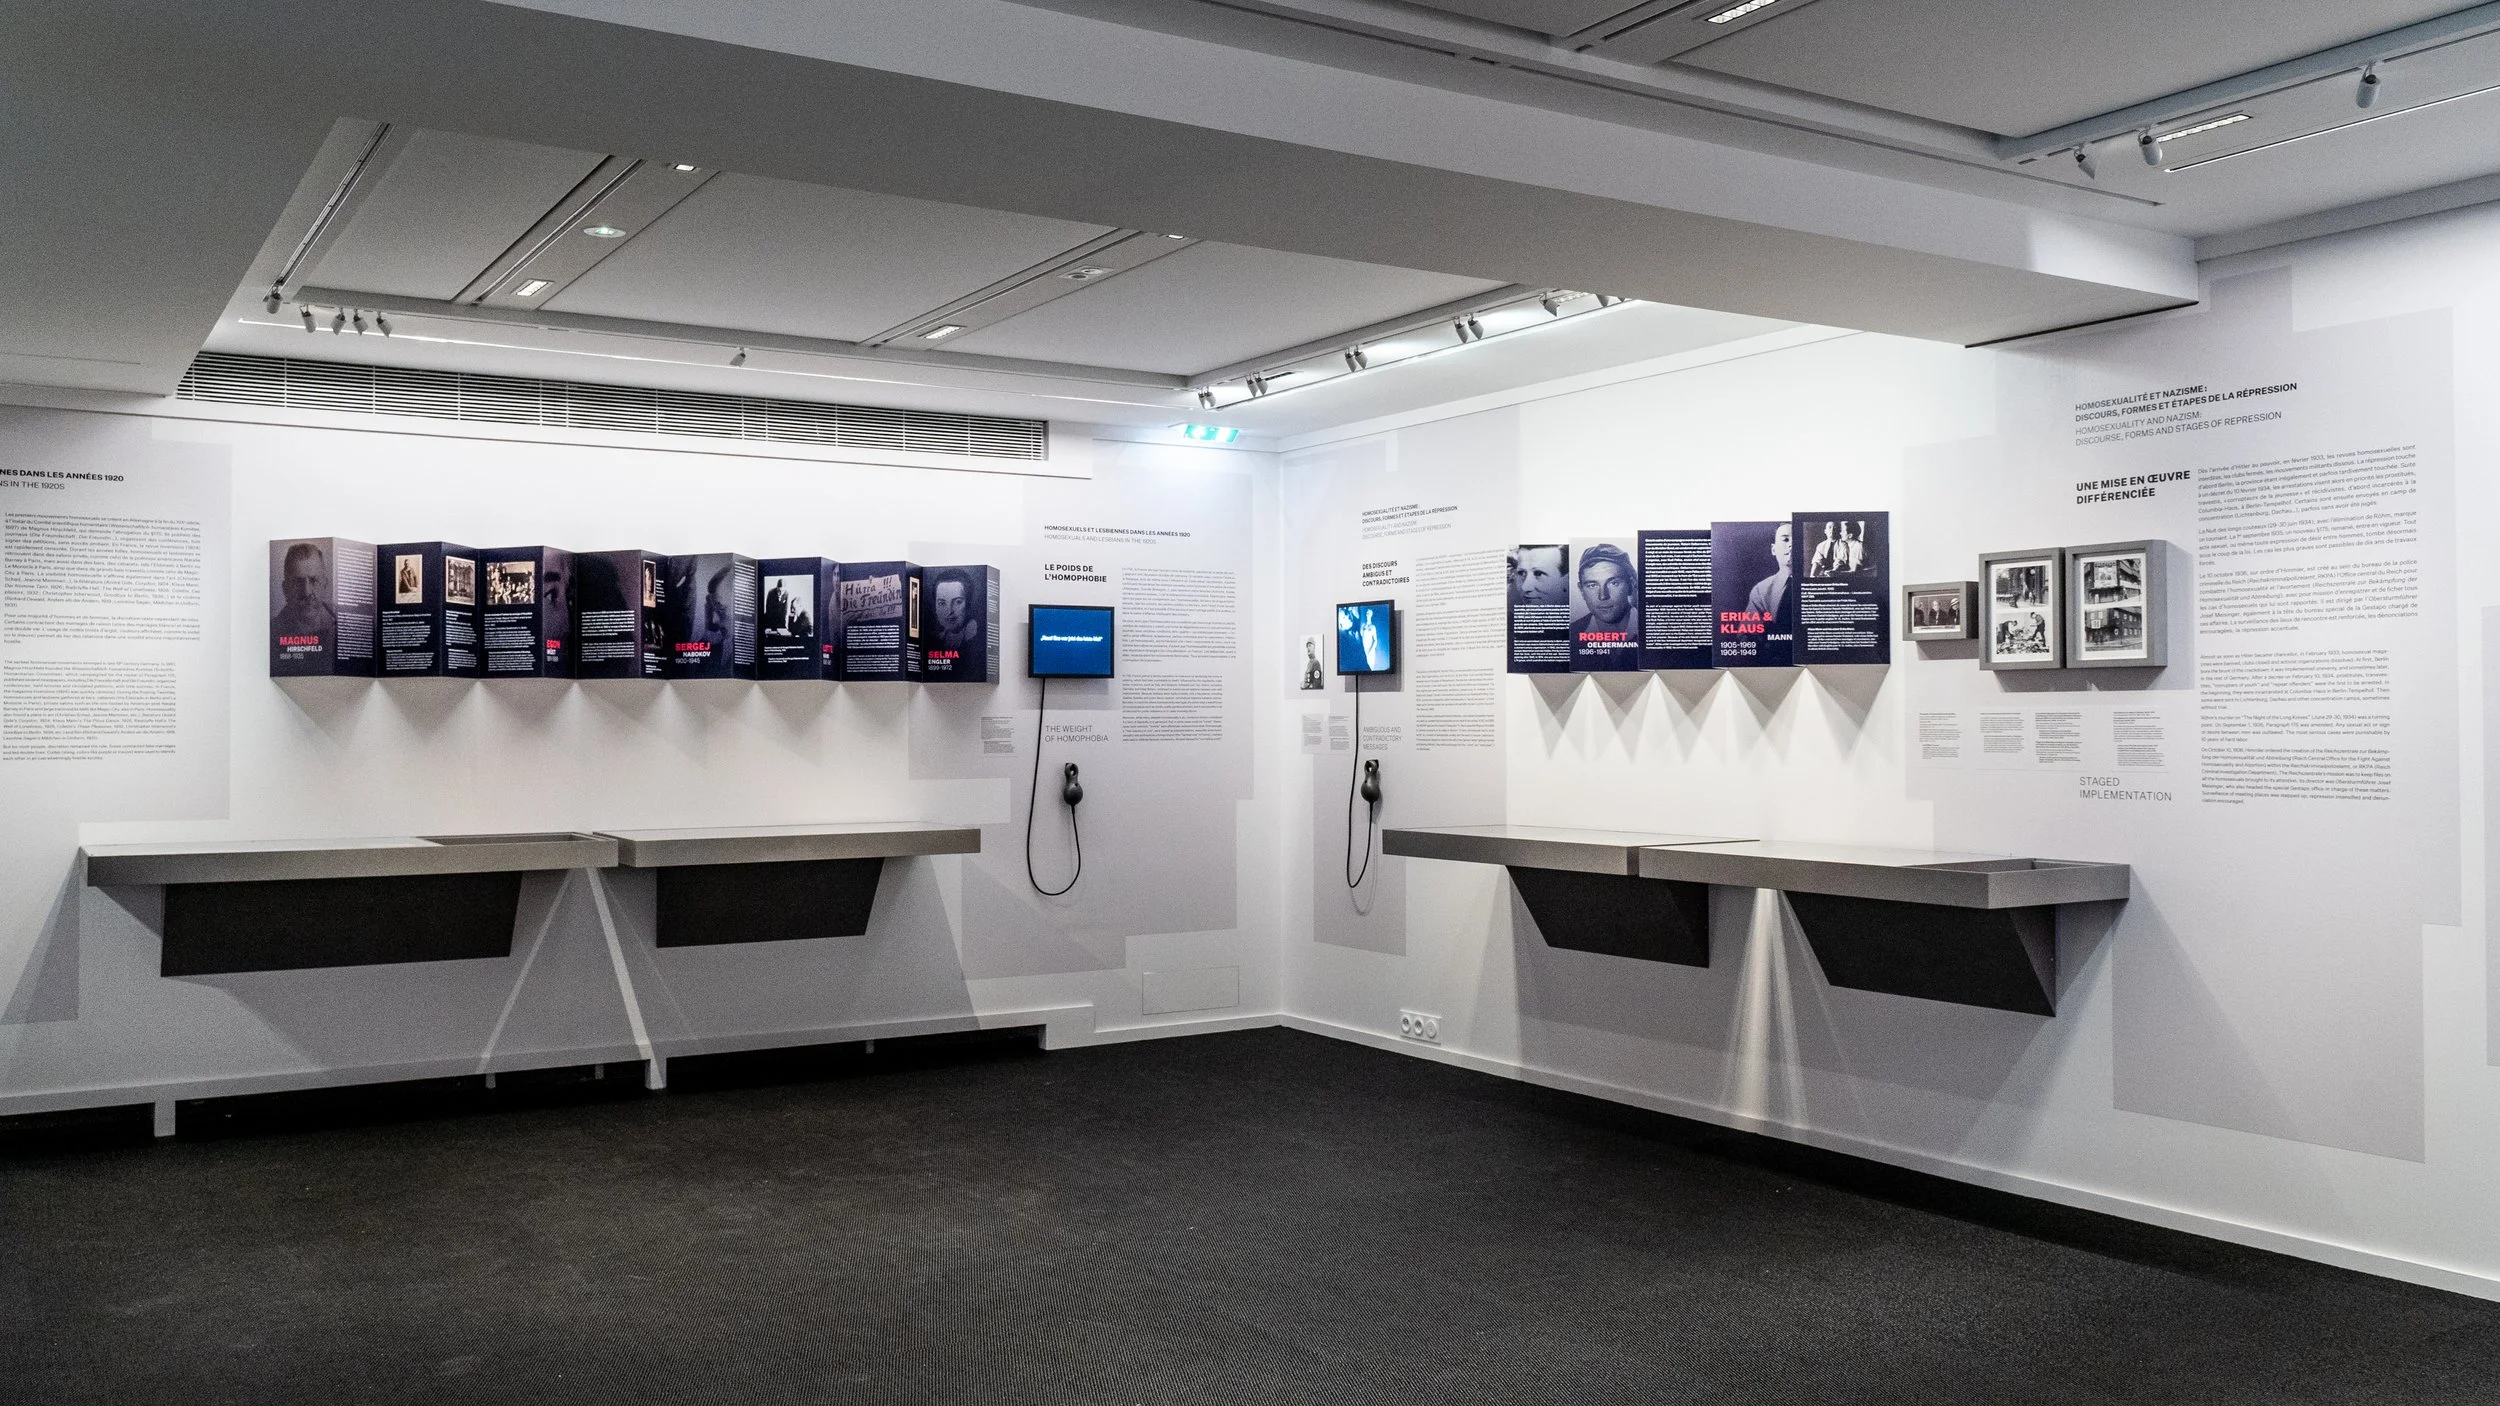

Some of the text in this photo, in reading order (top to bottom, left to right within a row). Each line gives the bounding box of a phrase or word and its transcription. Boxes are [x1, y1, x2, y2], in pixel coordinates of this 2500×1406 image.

[2075, 392, 2149, 411] HOMOSEXUALITÉ
[2149, 391, 2161, 400] ET
[2162, 385, 2203, 398] NAZISME
[2075, 382, 2298, 422] DISCOURS, FORMES ET ÉTAPES DE LA RÉPRESSION
[2075, 418, 2145, 436] HOMOSEXUALITY
[2146, 415, 2165, 426] AND
[2075, 411, 2282, 447] DISCOURSE, FORMS AND STAGES OF REPRESSION
[2357, 446, 2401, 456] homosexuelles
[19, 469, 46, 478] DANS
[46, 471, 65, 479] LES
[65, 471, 103, 481] ANNÉES
[103, 474, 125, 482] 1920
[10, 480, 20, 488] IN
[20, 481, 39, 489] THE
[40, 482, 65, 490] 1920S
[2076, 470, 2191, 492] UNE MISE EN ŒUVRE
[2076, 486, 2156, 505] DIFFÉRENCIÉE
[1056, 564, 1082, 572] POIDS
[1372, 561, 1398, 569] DISCOURS
[1362, 577, 1410, 587] CONTRADICTOIRES
[1720, 612, 1773, 622] ERIKA &
[1720, 623, 1765, 634] KLAUS
[279, 635, 319, 646] MAGNUS
[1579, 632, 1628, 642] ROBERT
[286, 645, 323, 653] HIRSCHFELD
[675, 642, 711, 652] SERGEJ
[1587, 641, 1639, 649] OELBERMANN
[1720, 641, 1757, 649] 1905-1969
[928, 650, 960, 659] SELMA
[1045, 725, 1093, 733] THE WEIGHT
[1045, 734, 1109, 743] OF HOMOPHOBIA
[2079, 776, 2120, 787] STAGED
[2079, 789, 2172, 802] IMPLEMENTATION
